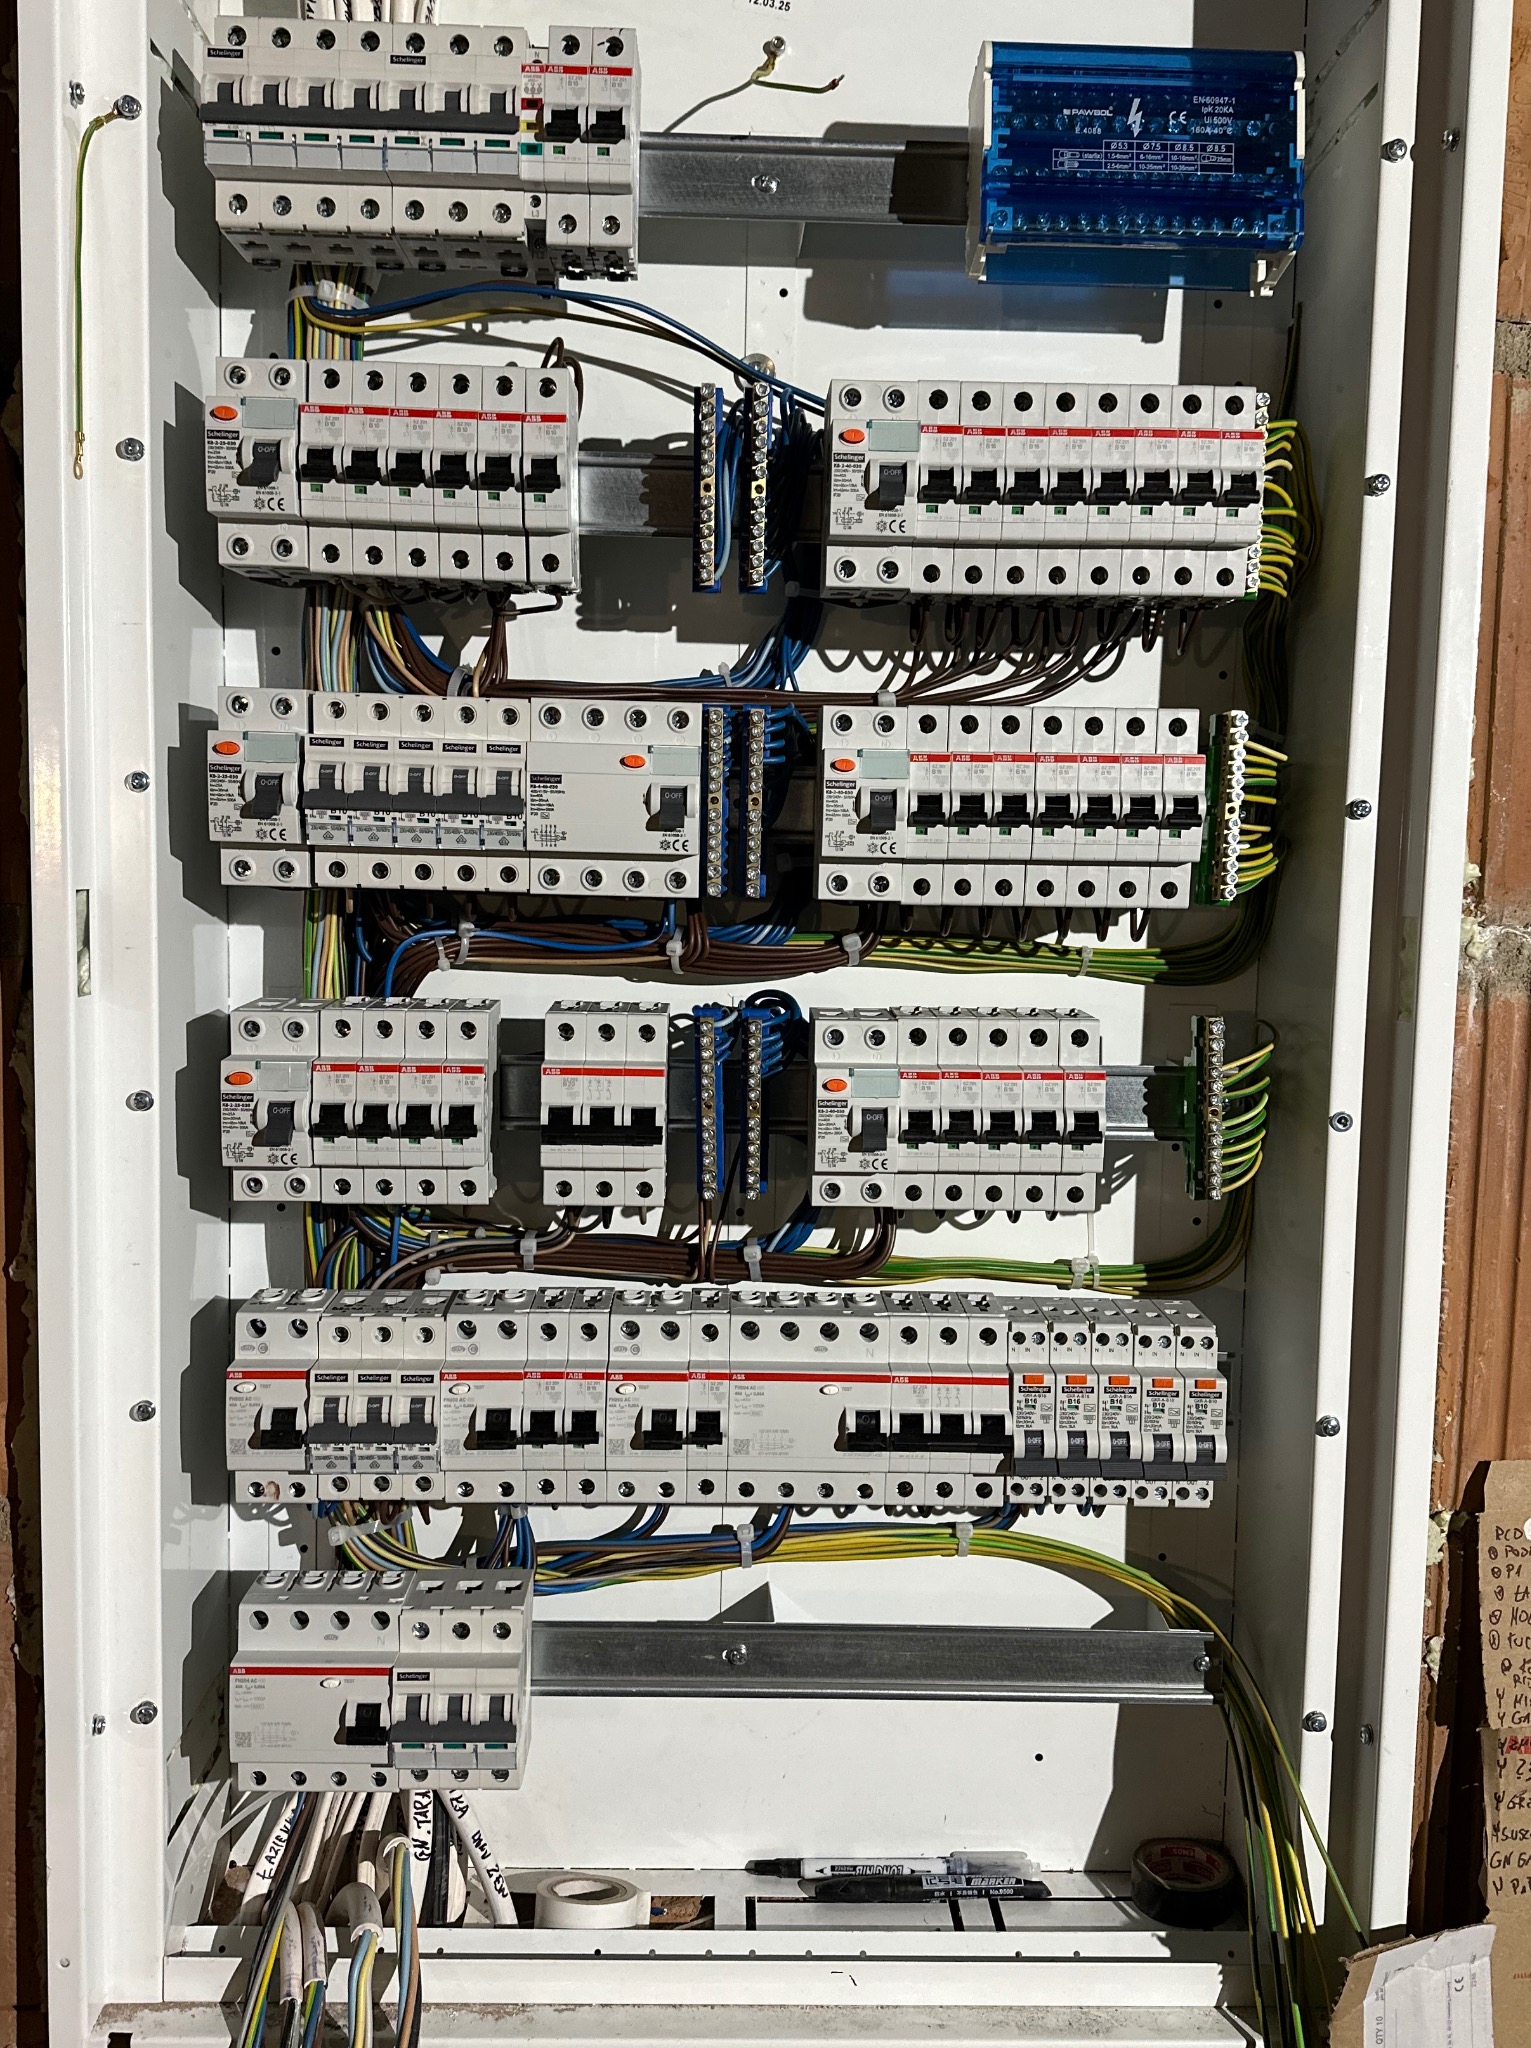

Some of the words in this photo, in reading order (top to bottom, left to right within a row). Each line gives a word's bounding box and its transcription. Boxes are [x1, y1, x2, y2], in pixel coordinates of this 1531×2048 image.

[1071, 108, 1113, 116] PAWBOL
[866, 1349, 874, 1358] N
[1496, 1526, 1524, 1541] RCD
[377, 1636, 385, 1645] N
[1376, 2016, 1383, 2026] 10
